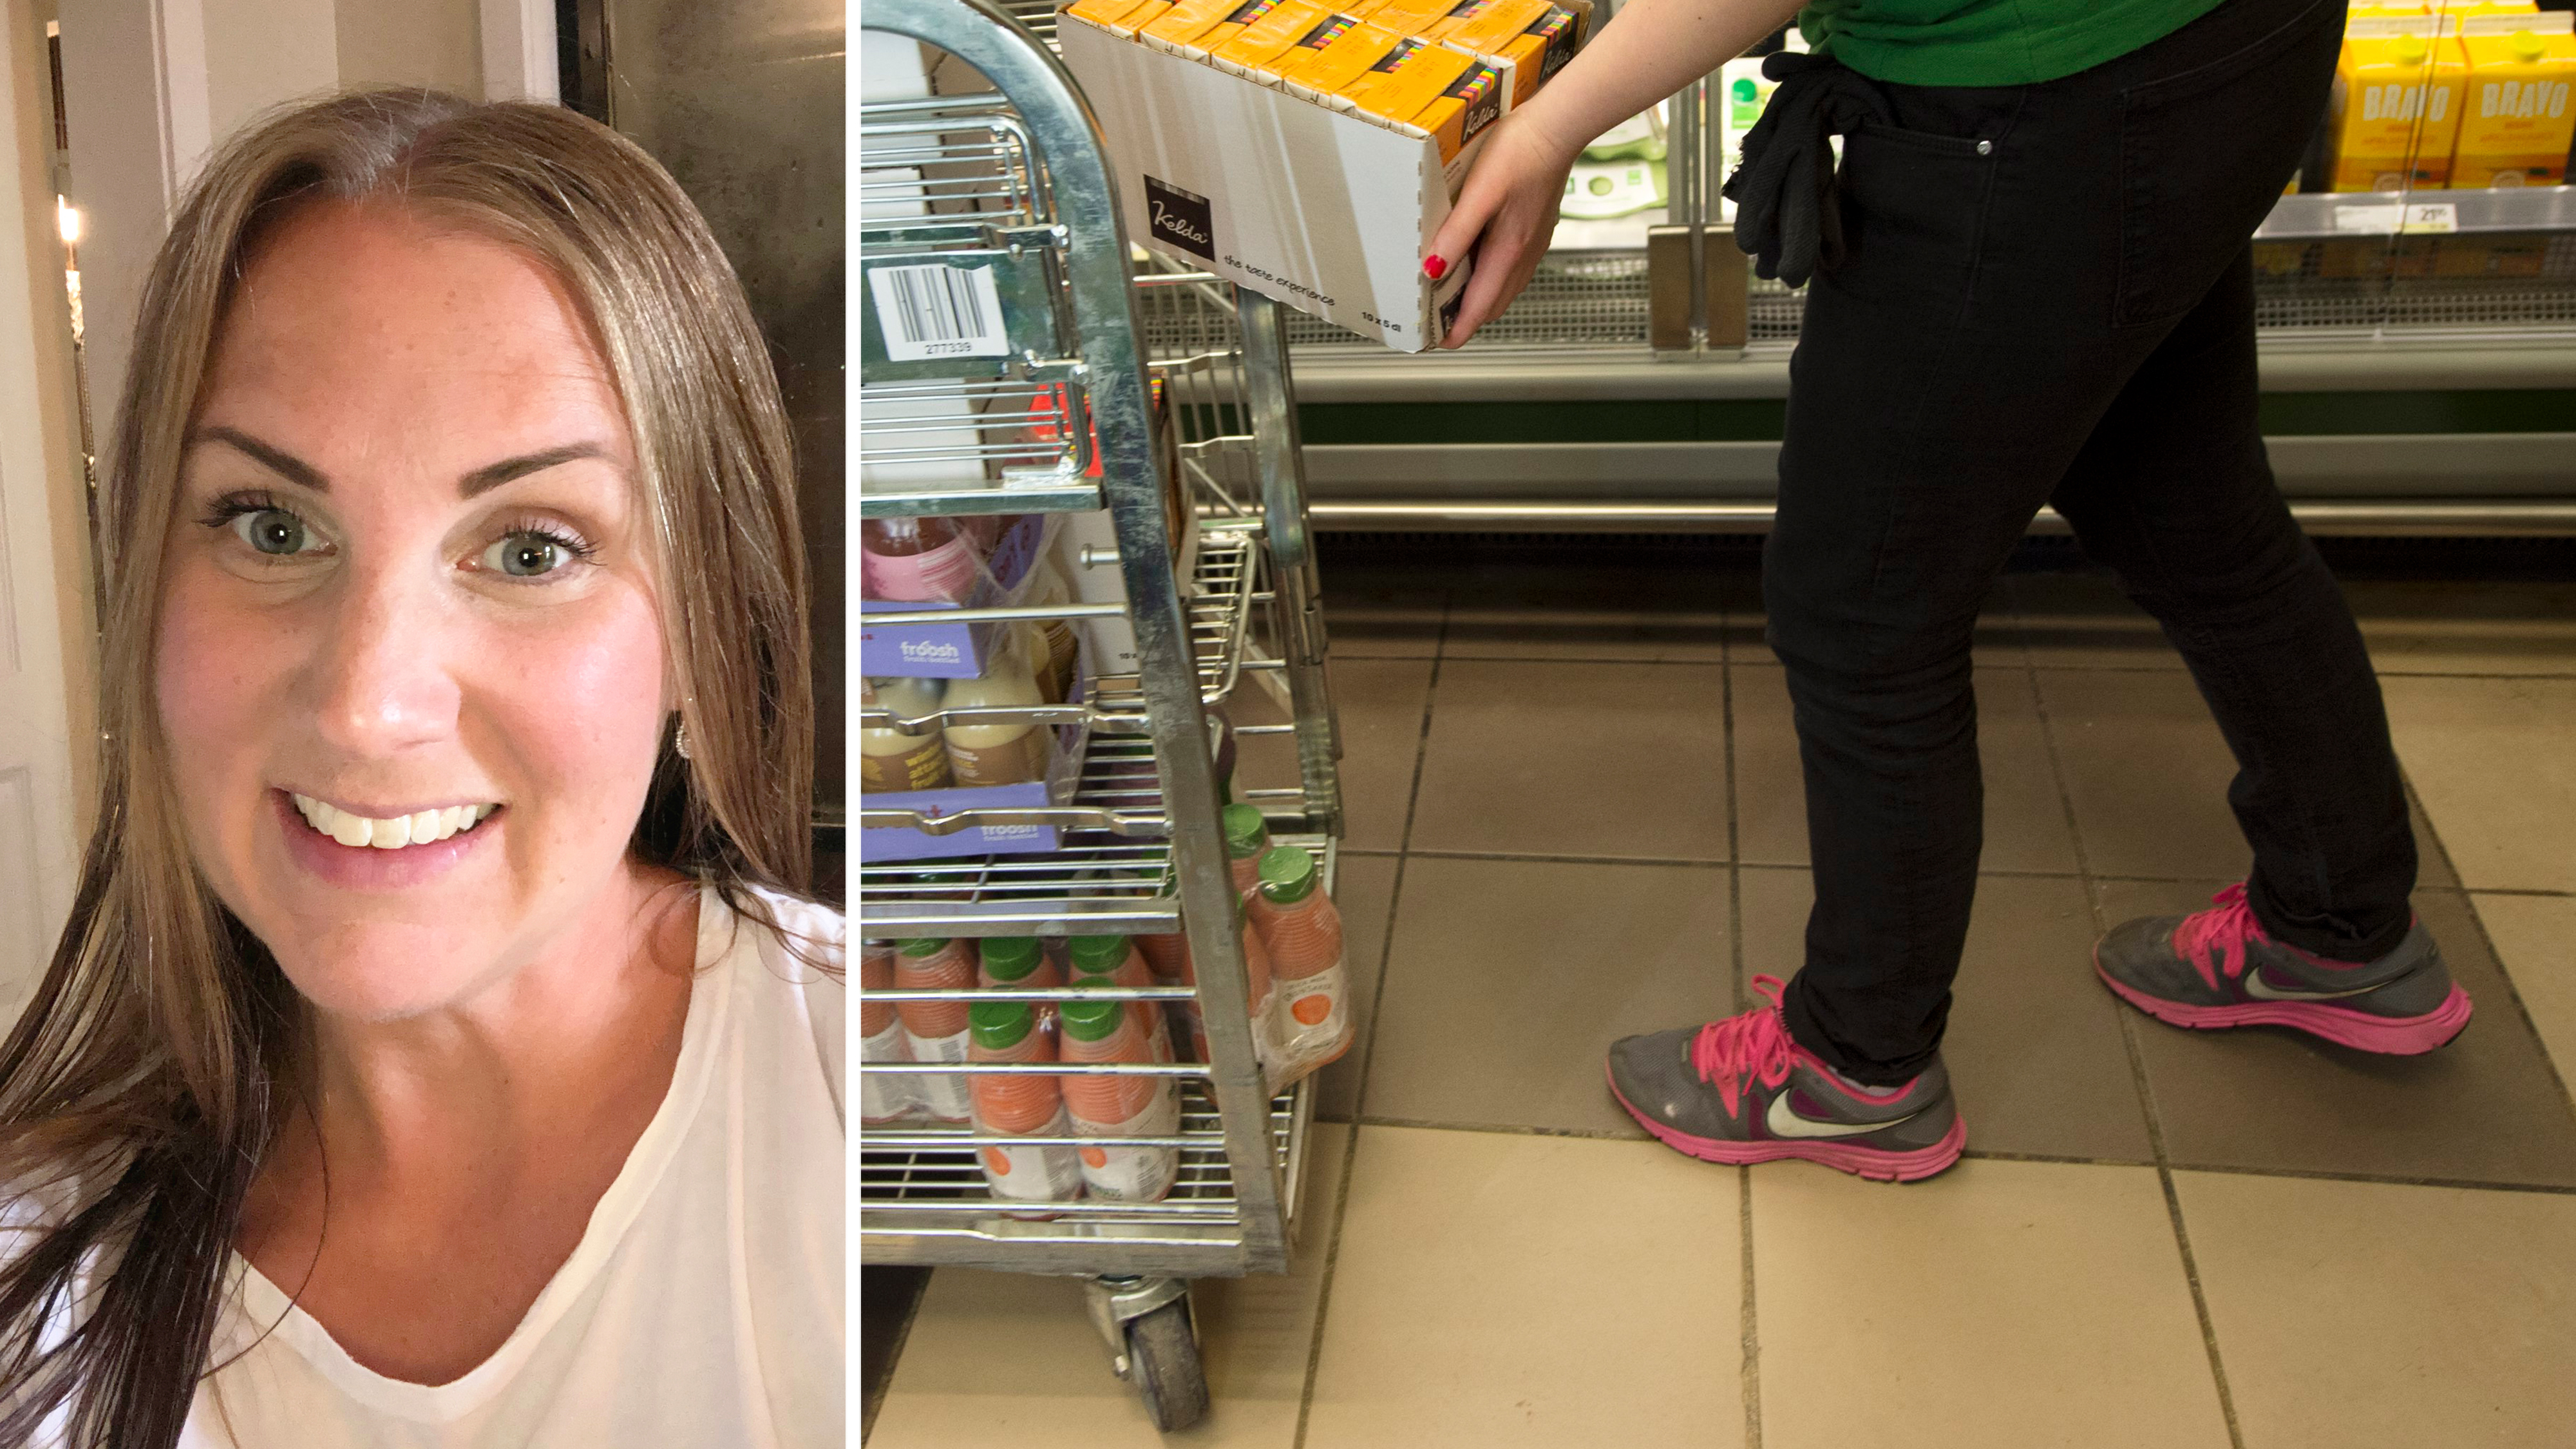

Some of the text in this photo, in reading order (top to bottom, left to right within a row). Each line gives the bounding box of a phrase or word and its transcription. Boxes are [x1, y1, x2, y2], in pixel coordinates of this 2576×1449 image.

[2481, 81, 2569, 118] BRAVO
[1463, 104, 1498, 142] Kelda
[1153, 200, 1208, 244] Kelda
[1224, 255, 1336, 307] the taste experience
[1361, 312, 1374, 322] 10
[1392, 324, 1401, 332] dl
[925, 342, 971, 354] 277339
